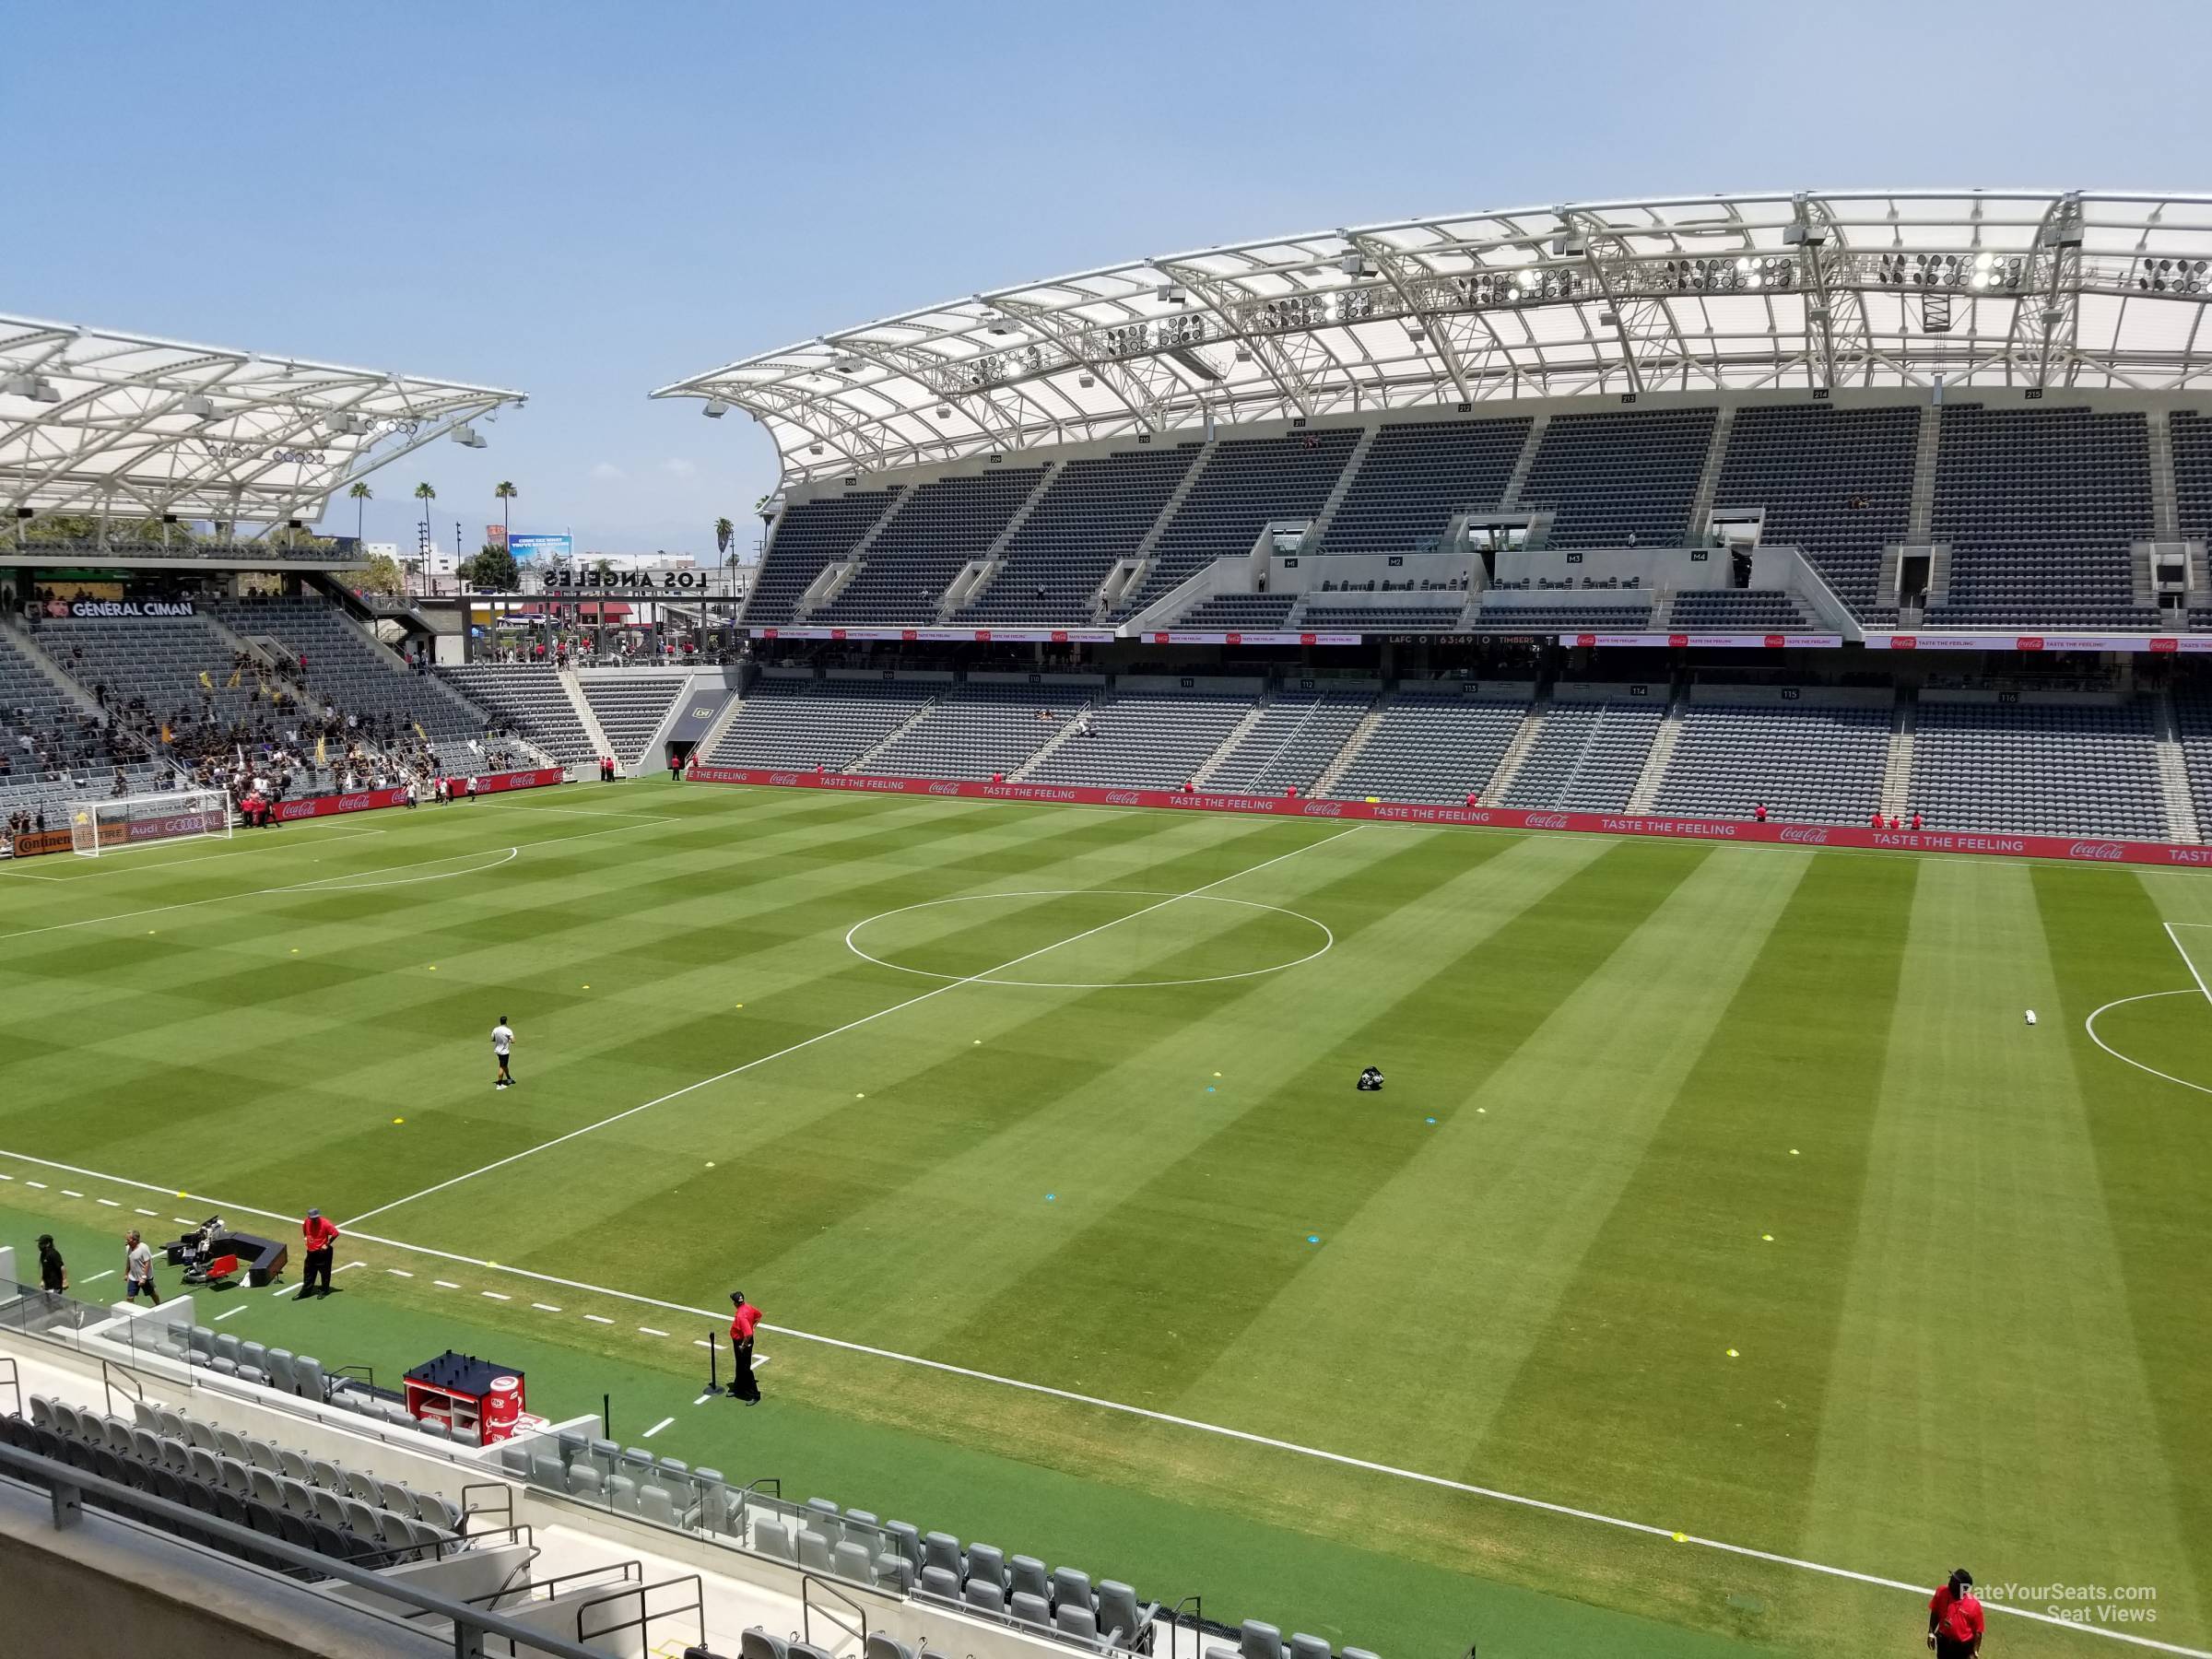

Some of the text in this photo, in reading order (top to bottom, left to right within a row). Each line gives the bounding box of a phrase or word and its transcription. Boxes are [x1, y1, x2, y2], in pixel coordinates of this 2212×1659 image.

[1390, 558, 1401, 566] M2
[73, 601, 193, 617] GÉNÉRAL CIMAN
[1783, 690, 1796, 699] 115
[2002, 694, 2017, 702] 116
[712, 771, 747, 781] FEELING
[820, 778, 904, 790] TASTE THE FEELING
[983, 787, 1075, 799] TASTE THE FEELING
[1170, 796, 1274, 809] TASTE THE FEELING
[1372, 806, 1489, 821] TASTE THE FEELING
[131, 824, 158, 835] Audi
[1602, 818, 1735, 835] TASTE THE FEELING
[1873, 833, 2024, 851] TASTE THE FEELING
